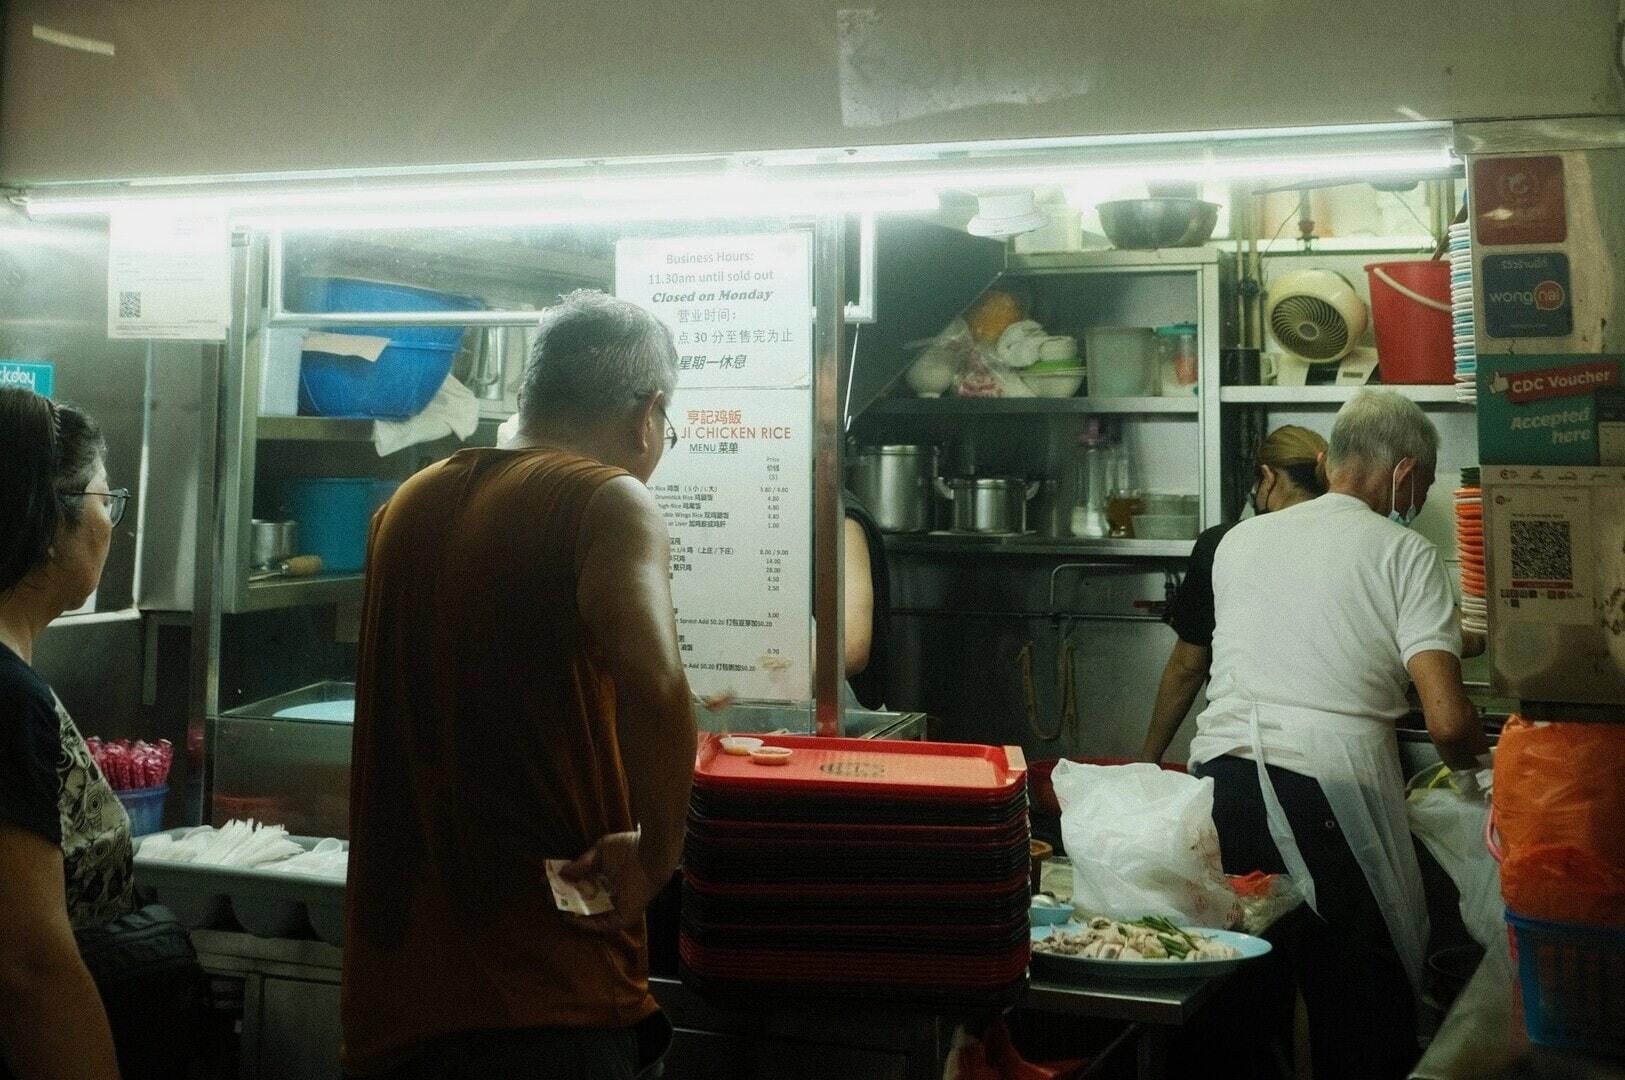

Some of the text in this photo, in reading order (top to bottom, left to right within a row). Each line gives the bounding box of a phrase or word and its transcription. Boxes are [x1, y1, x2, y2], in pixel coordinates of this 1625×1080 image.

[666, 251, 754, 265] Business Hours:
[648, 270, 774, 285] 11.30am until sold out
[652, 290, 774, 304] Closed on Monday
[677, 308, 737, 323] 营业时间:
[677, 328, 794, 346] 点 30 分至售完为止
[678, 354, 747, 370] 星期一休息
[1512, 370, 1611, 394] CDC Voucher
[1510, 407, 1590, 431] Accepted
[681, 426, 691, 439] JI
[695, 426, 756, 440] CHICKEN
[761, 426, 792, 439] RICE
[1552, 428, 1591, 444] here
[689, 442, 739, 454] MENU 菜单
